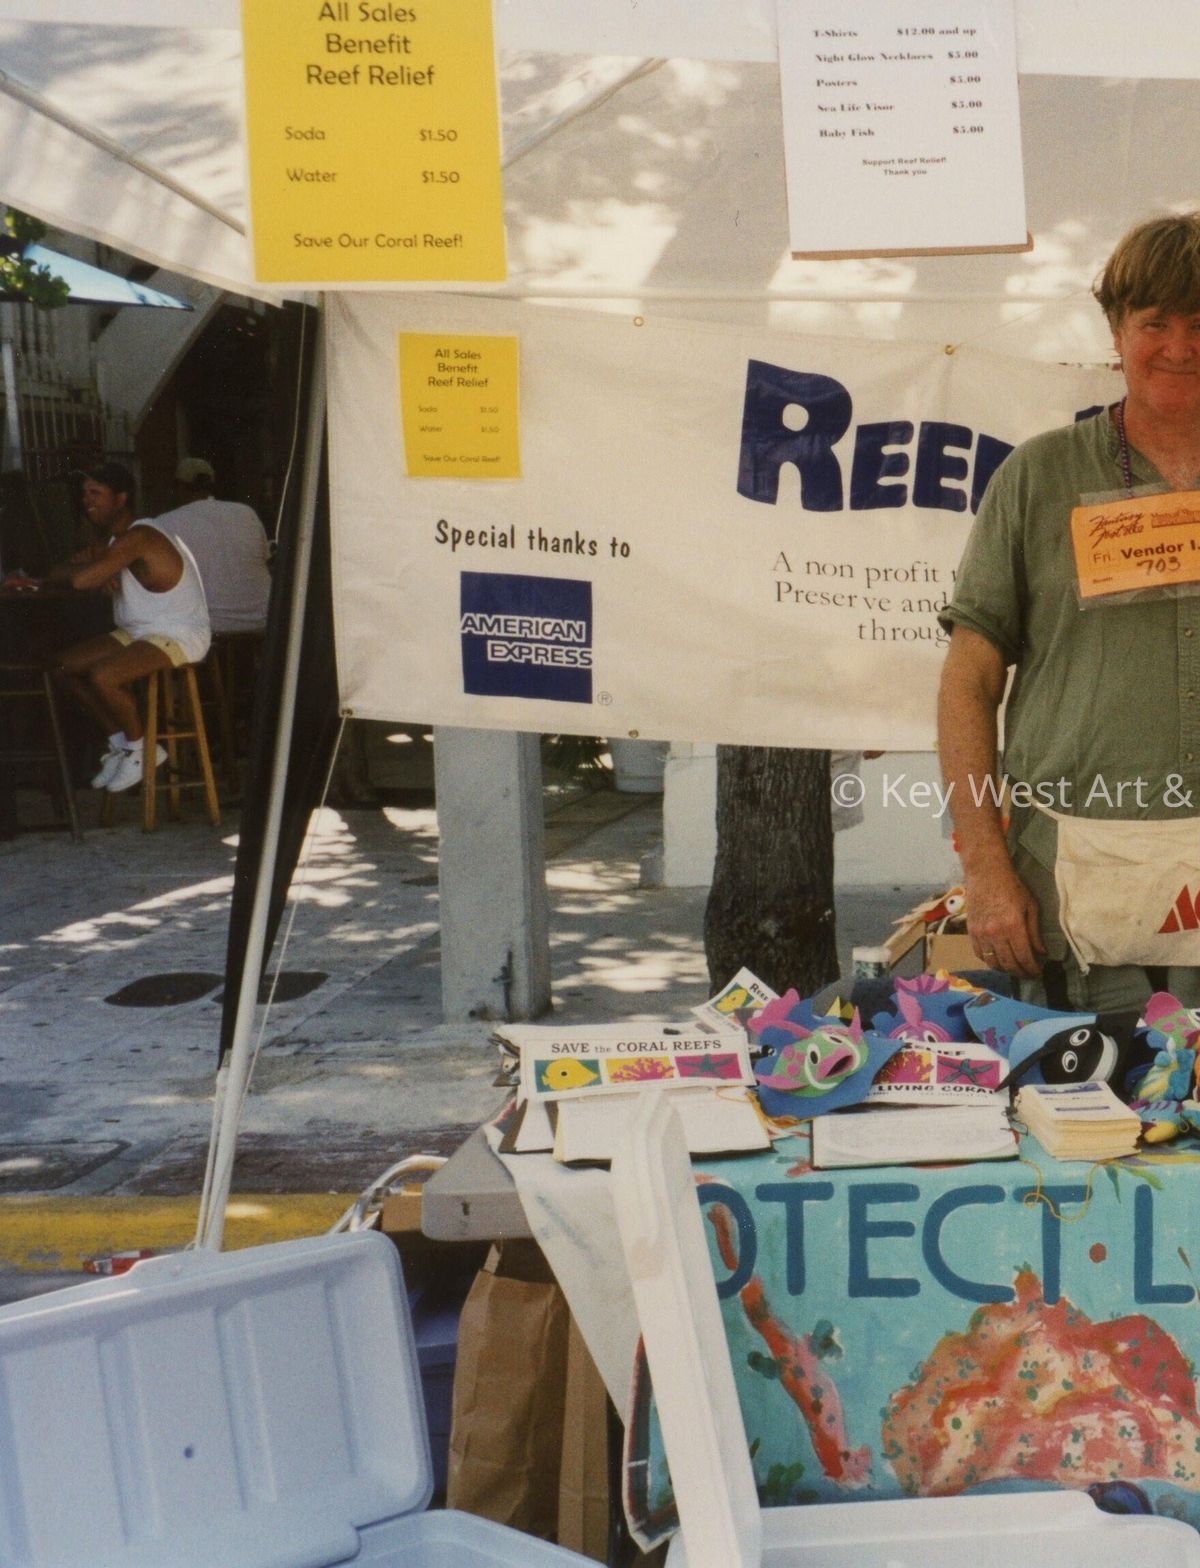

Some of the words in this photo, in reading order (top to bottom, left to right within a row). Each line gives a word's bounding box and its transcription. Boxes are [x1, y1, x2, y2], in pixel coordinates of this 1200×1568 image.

[318, 2, 348, 22] All
[359, 2, 416, 22] Sales
[814, 30, 858, 38] T-Shirts
[897, 27, 935, 36] $12.00
[939, 27, 959, 35] and
[963, 28, 976, 38] up
[326, 33, 411, 54] Benefit
[815, 54, 844, 64] Night
[848, 53, 875, 62] Glow
[880, 53, 933, 62] Necklaces
[948, 50, 978, 60] $5.00
[306, 64, 360, 85] Reef
[369, 65, 434, 86] Relief
[816, 79, 857, 88] Posters
[950, 75, 981, 84] $5.00
[817, 104, 837, 112] Sea
[841, 103, 861, 112] Life
[866, 103, 894, 111] Visor
[951, 100, 982, 110] $5.00
[285, 127, 325, 141] Soda
[419, 129, 458, 143] $1.50
[819, 129, 846, 139] Baby
[851, 129, 875, 137] Fish
[953, 125, 984, 135] $5.00
[862, 158, 895, 167] Support
[898, 157, 917, 165] Reef
[286, 168, 337, 183] Water
[422, 170, 460, 184] $1.50
[883, 168, 909, 176] Thank
[912, 169, 927, 177] you
[294, 234, 332, 248] Save
[338, 234, 368, 248] Our
[375, 234, 417, 248] Coral
[424, 234, 463, 248] Reef!
[435, 348, 450, 358] All
[454, 349, 482, 360] Sales
[437, 362, 478, 373] Benefit
[428, 376, 453, 387] Reef
[457, 377, 488, 388] Relief
[435, 519, 516, 552] Special
[527, 528, 598, 557] thanks
[609, 536, 631, 558] to
[1121, 542, 1184, 560] Vendor
[773, 551, 792, 573] A
[806, 560, 854, 579] non
[865, 560, 939, 589] profit
[1136, 556, 1181, 576] 703
[775, 581, 891, 613] Preserve
[460, 612, 586, 642] AMERICAN
[487, 642, 592, 669] EXPRESS
[551, 1043, 590, 1054] SAVE
[594, 1045, 612, 1053] the
[617, 1041, 668, 1053] CORAL
[672, 1039, 722, 1051] REEFS
